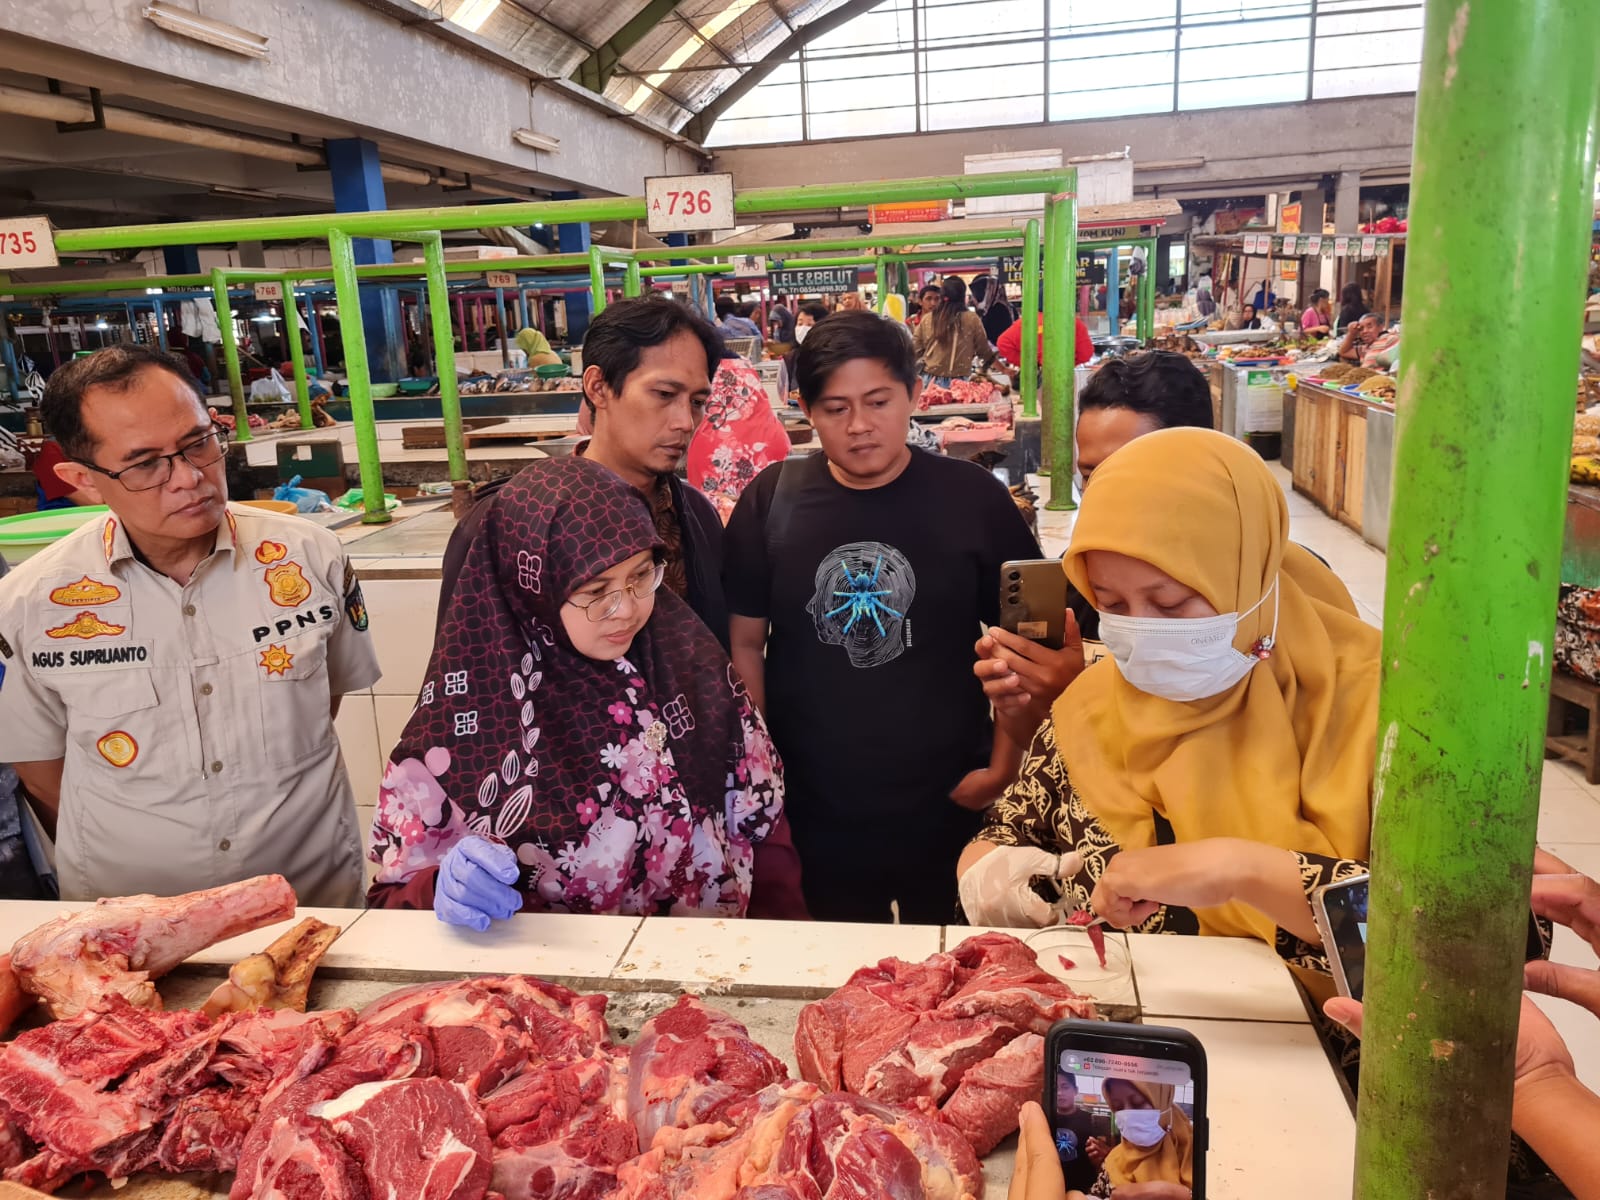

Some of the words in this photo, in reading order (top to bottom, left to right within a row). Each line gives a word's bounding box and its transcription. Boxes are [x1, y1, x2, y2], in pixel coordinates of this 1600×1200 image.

[653, 198, 660, 210] A
[667, 190, 712, 215] 736
[0, 231, 37, 254] 735
[252, 605, 333, 643] PPNS
[32, 651, 65, 668] AGUS
